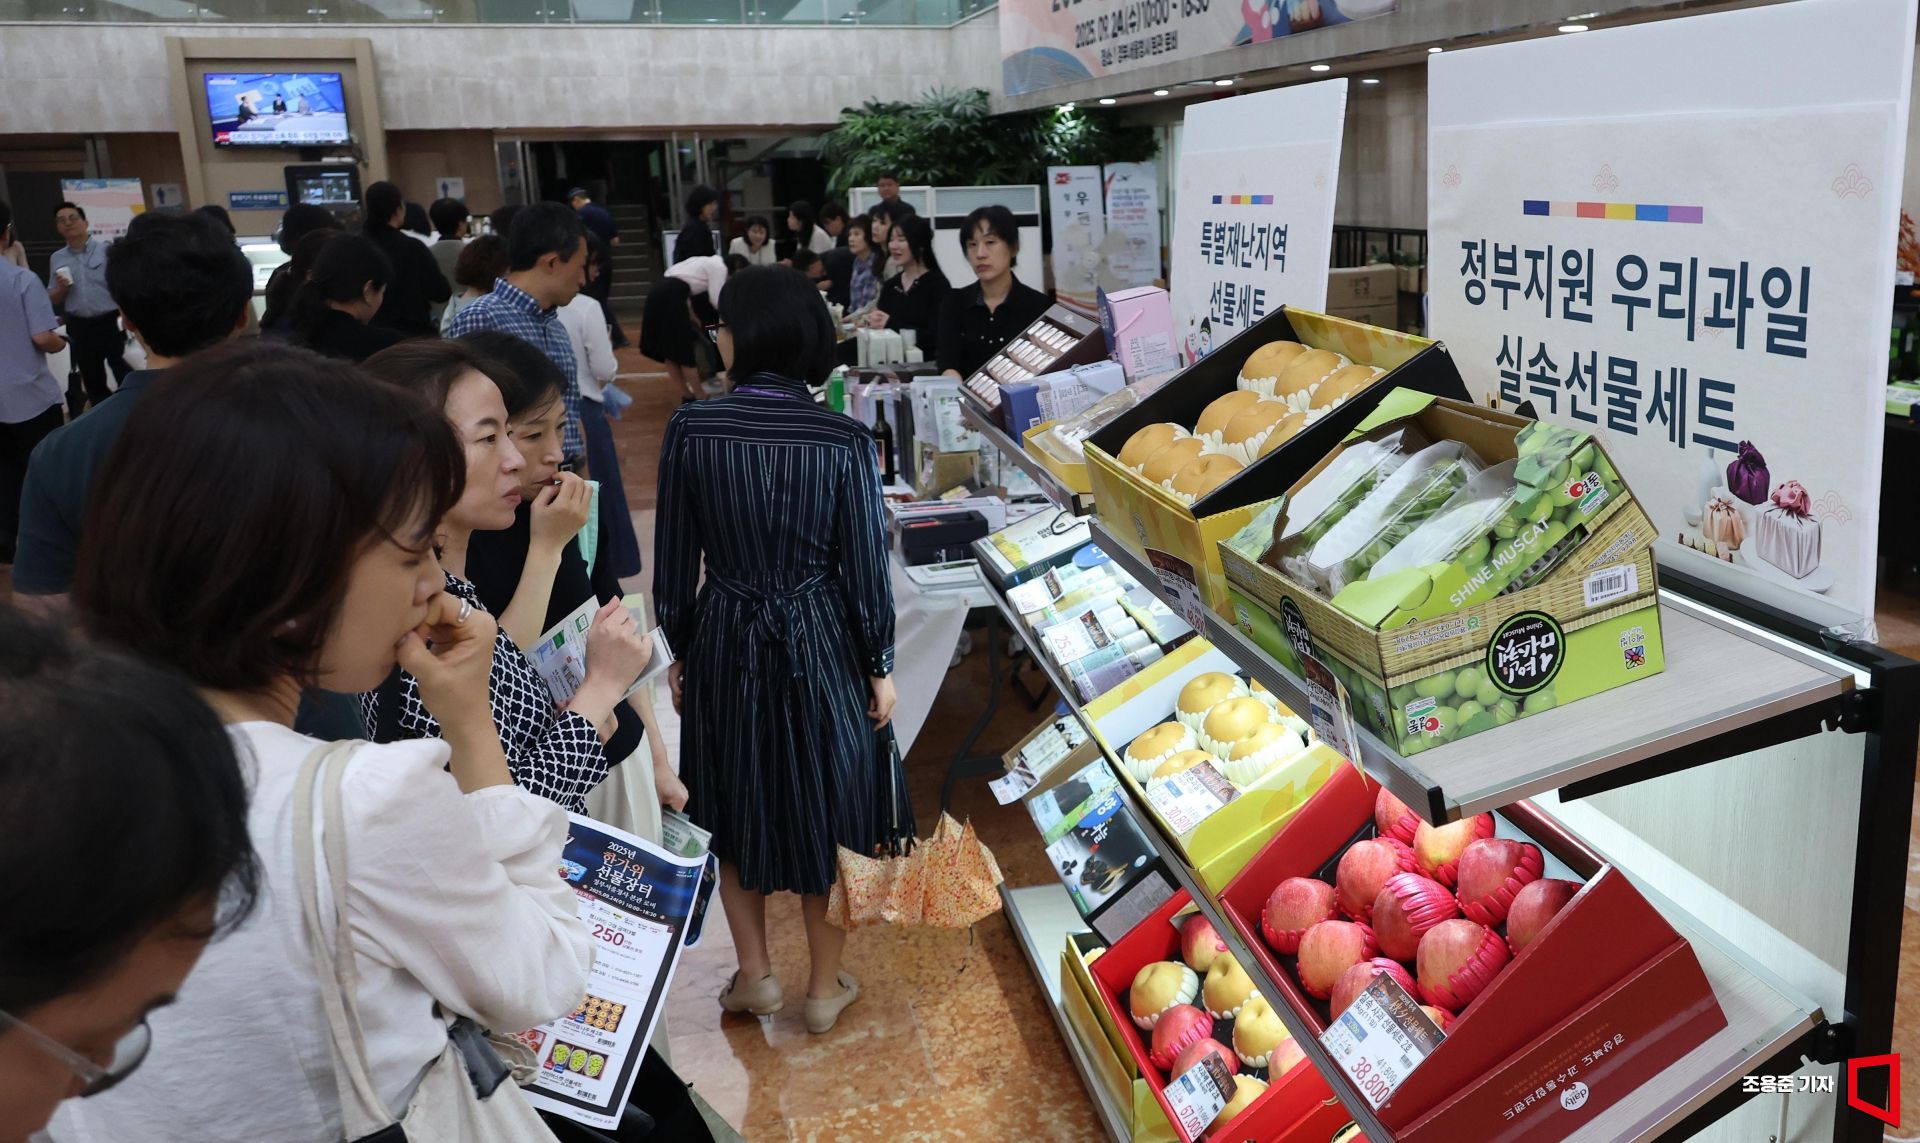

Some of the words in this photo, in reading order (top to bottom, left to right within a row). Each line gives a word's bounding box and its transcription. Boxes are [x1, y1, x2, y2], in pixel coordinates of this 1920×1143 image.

[1200, 221, 1288, 273] 특별재난지역
[1209, 280, 1266, 328] 선물세트
[1460, 238, 1595, 324] 정부지원
[1611, 254, 1811, 359] 우리과일
[1496, 334, 1740, 453] 실속선물세트
[1450, 566, 1494, 608] SHINE
[1493, 516, 1550, 572] MUSCAT
[1502, 627, 1525, 640] Muscat
[1524, 620, 1544, 632] Shine
[1495, 632, 1555, 668] 머스켓
[1508, 652, 1554, 684] 샤인
[603, 852, 645, 879] 한가위
[607, 842, 637, 860] 2025년
[596, 866, 653, 899] 선물장터
[592, 923, 625, 947] 250
[1360, 994, 1373, 1009] 실속
[1372, 1007, 1385, 1020] 사과
[1383, 1019, 1405, 1044] 선물세트
[1400, 1042, 1413, 1053] 2호
[1403, 1016, 1429, 1043] 선물세트
[1580, 1033, 1627, 1068] 경상북도
[1351, 1056, 1390, 1104] 38,800
[1502, 1064, 1581, 1121] 과수통합브랜드
[1563, 1087, 1588, 1109] daily
[1180, 1105, 1203, 1138] 67,000
